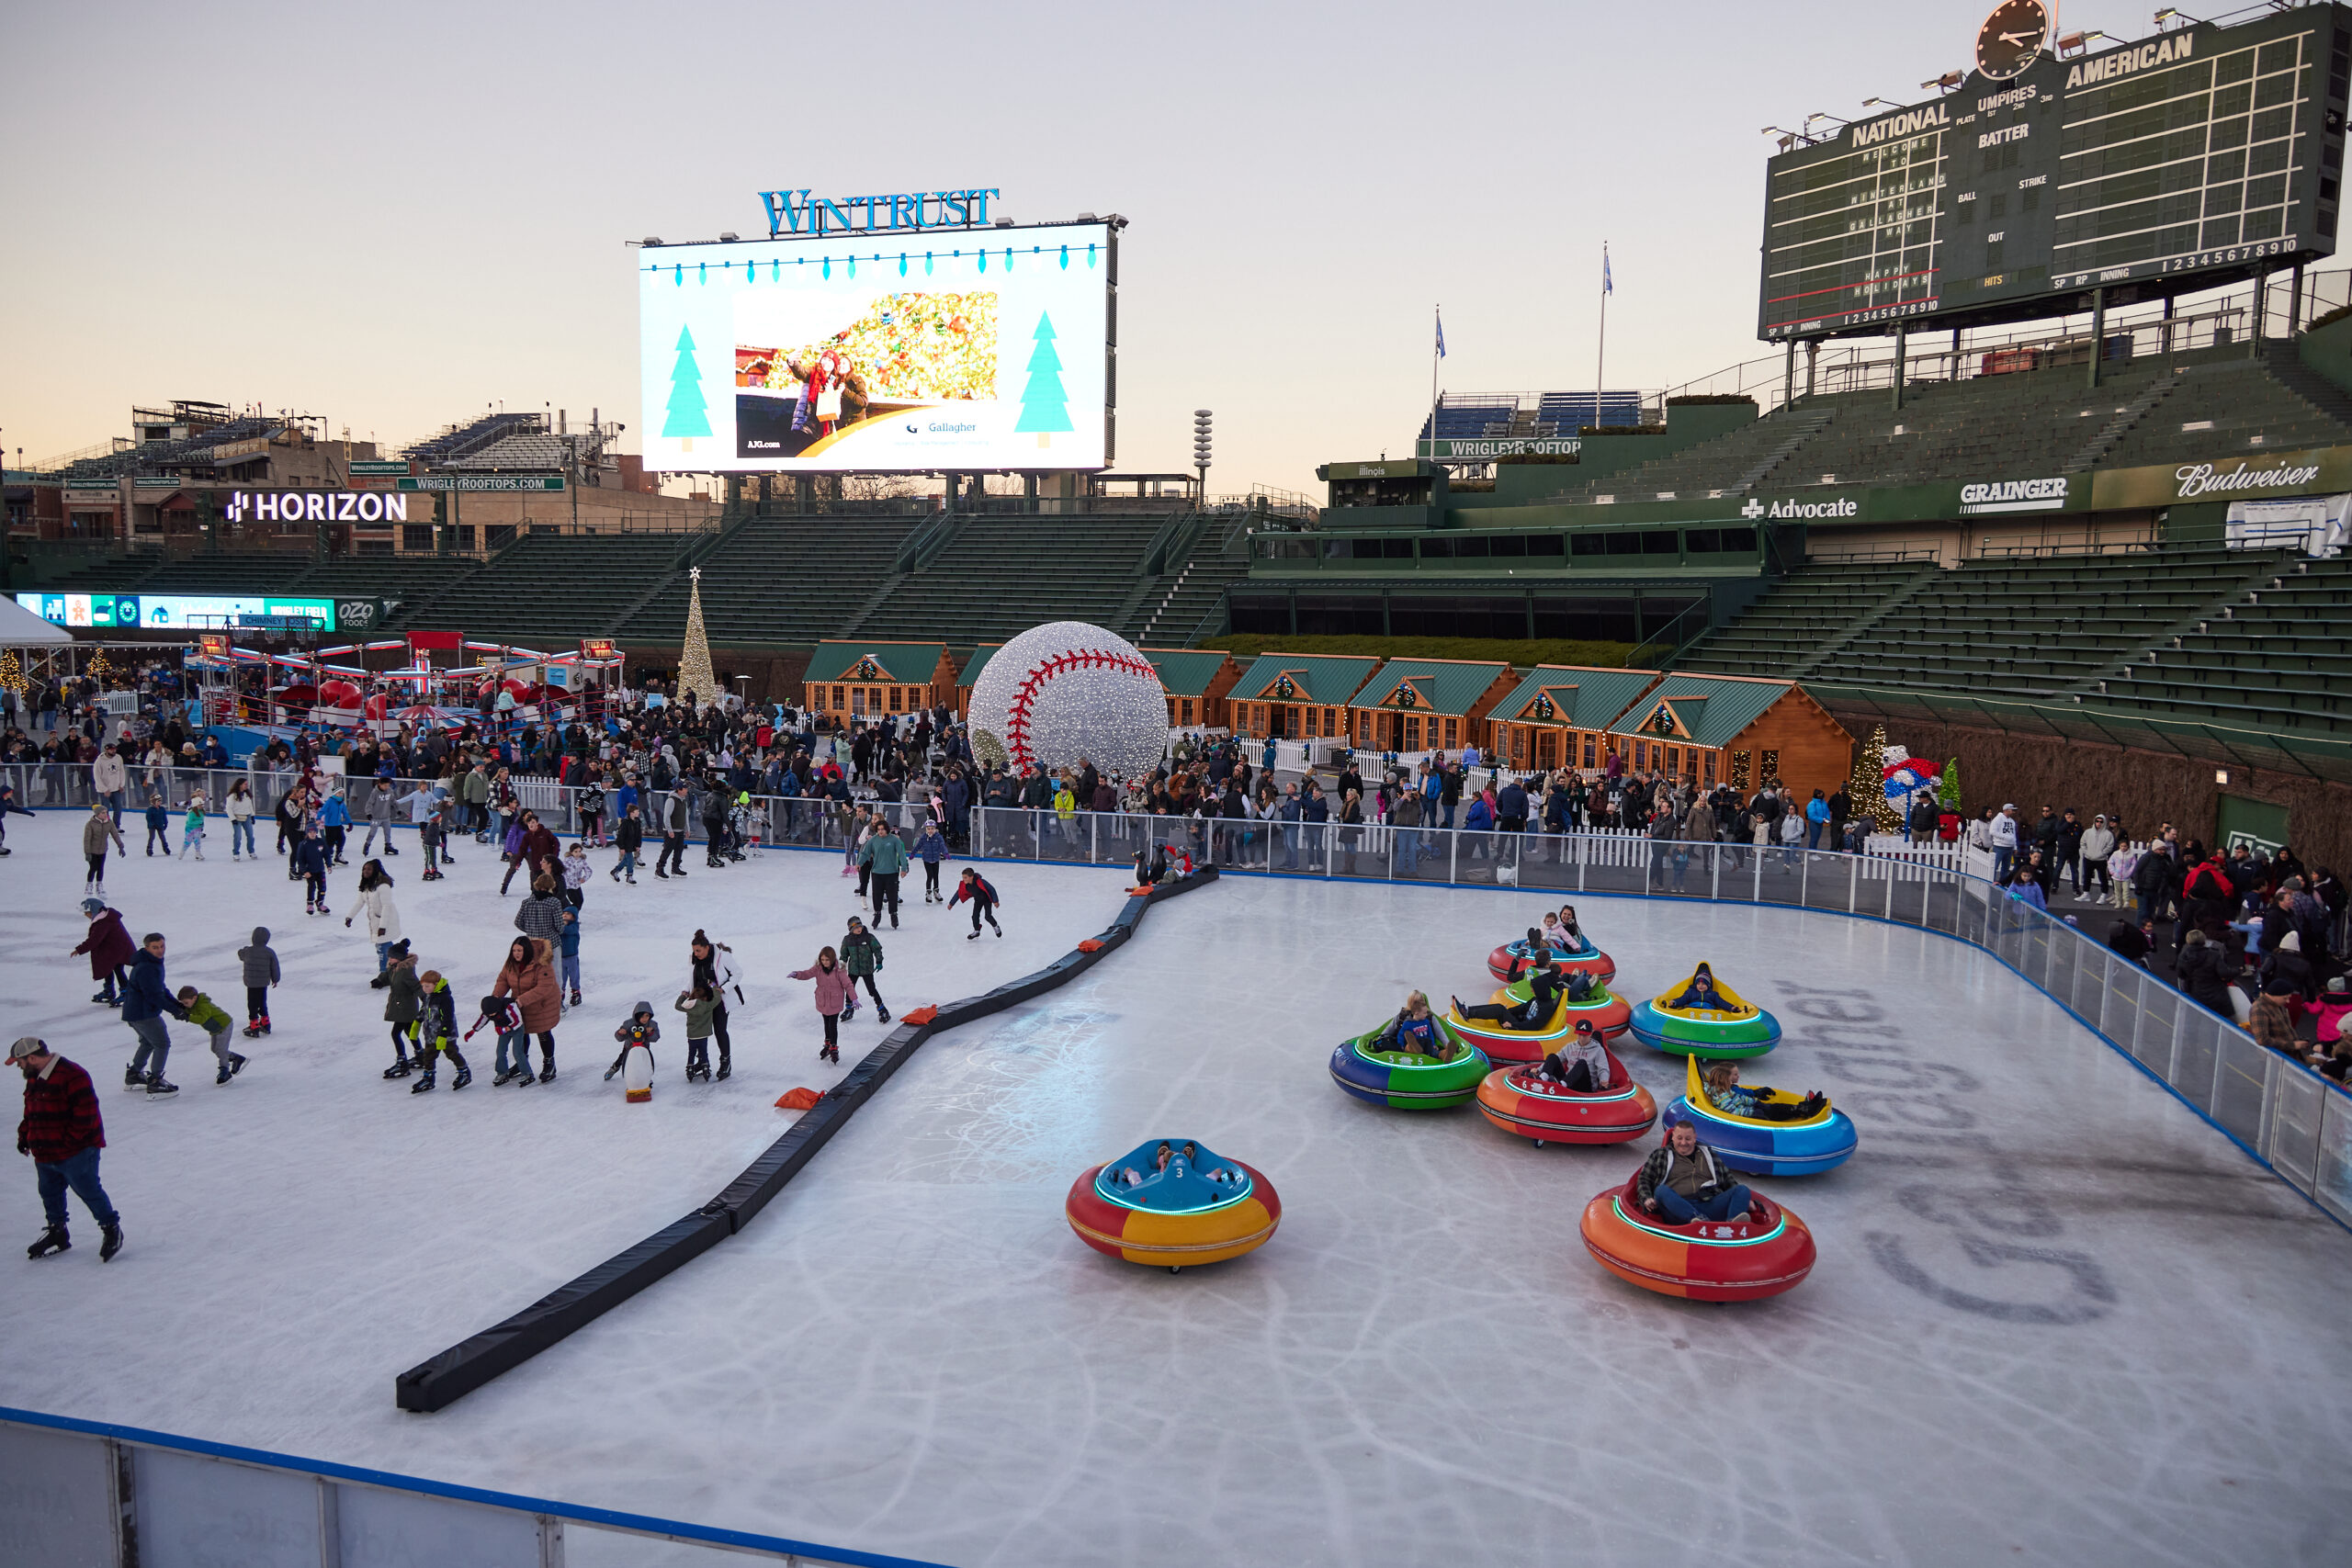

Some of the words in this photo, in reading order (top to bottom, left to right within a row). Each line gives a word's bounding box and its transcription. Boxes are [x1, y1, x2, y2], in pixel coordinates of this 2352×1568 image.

[2065, 33, 2193, 89] AMERICAN
[1978, 85, 2036, 112] UMPIRES
[1956, 114, 1976, 126] PLATE
[2012, 102, 2026, 110] 2ND
[2040, 95, 2053, 103] 3RD
[1852, 103, 1950, 148] NATIONAL
[1978, 123, 2030, 149] BATTER
[1863, 139, 1927, 162] WELCOME
[1892, 157, 1906, 167] TO
[1851, 175, 1945, 204] WINTERLAND
[2018, 175, 2047, 189] STRIKE
[1889, 198, 1903, 209] AT
[1958, 191, 1977, 203] BALL
[758, 188, 1000, 235] WINTRUST
[1850, 206, 1933, 231] GALLAGHER
[1886, 224, 1911, 236] WAY
[1988, 231, 2005, 243] OUT
[1865, 265, 1909, 281] HAPPY
[2053, 278, 2066, 289] SP
[2075, 275, 2088, 286] RP
[2100, 267, 2130, 281] INNING
[2173, 259, 2182, 271] 2
[2187, 256, 2196, 268] 3
[2199, 254, 2210, 266] 4
[2213, 252, 2222, 264] 5
[2227, 249, 2236, 262] 6
[2242, 247, 2251, 260] 7
[2255, 244, 2265, 257] 8
[2269, 243, 2279, 254] 9
[2282, 239, 2297, 253] 10
[1855, 276, 1928, 296] HOLIDAYS
[1984, 275, 2003, 287] HITS
[1769, 328, 1778, 337] SP
[1783, 325, 1792, 334] RP
[1800, 321, 1821, 332] INNING
[1852, 313, 1860, 324] 2
[1862, 312, 1870, 322] 3
[1871, 310, 1878, 321] 4
[1881, 309, 1887, 319] 5
[1890, 307, 1897, 318] 6
[1900, 305, 1907, 316] 7
[1909, 304, 1917, 314] 8
[1919, 302, 1926, 312] 9
[1928, 300, 1938, 311] 10
[929, 423, 977, 434] Gallagher
[2176, 460, 2319, 497] Budweiser
[1960, 478, 2067, 503] GRAINGER
[256, 492, 408, 521] HORIZON
[1769, 497, 1858, 519] Advocate
[245, 616, 283, 625] CHIMNEY
[270, 605, 304, 616] WRIGLEY
[1388, 1055, 1395, 1063] 5
[1418, 1057, 1423, 1066] 5
[1521, 1080, 1527, 1089] 6
[1548, 1086, 1555, 1095] 6
[1176, 1168, 1183, 1179] 3
[1698, 1225, 1708, 1237] 4
[1739, 1226, 1747, 1237] 4
